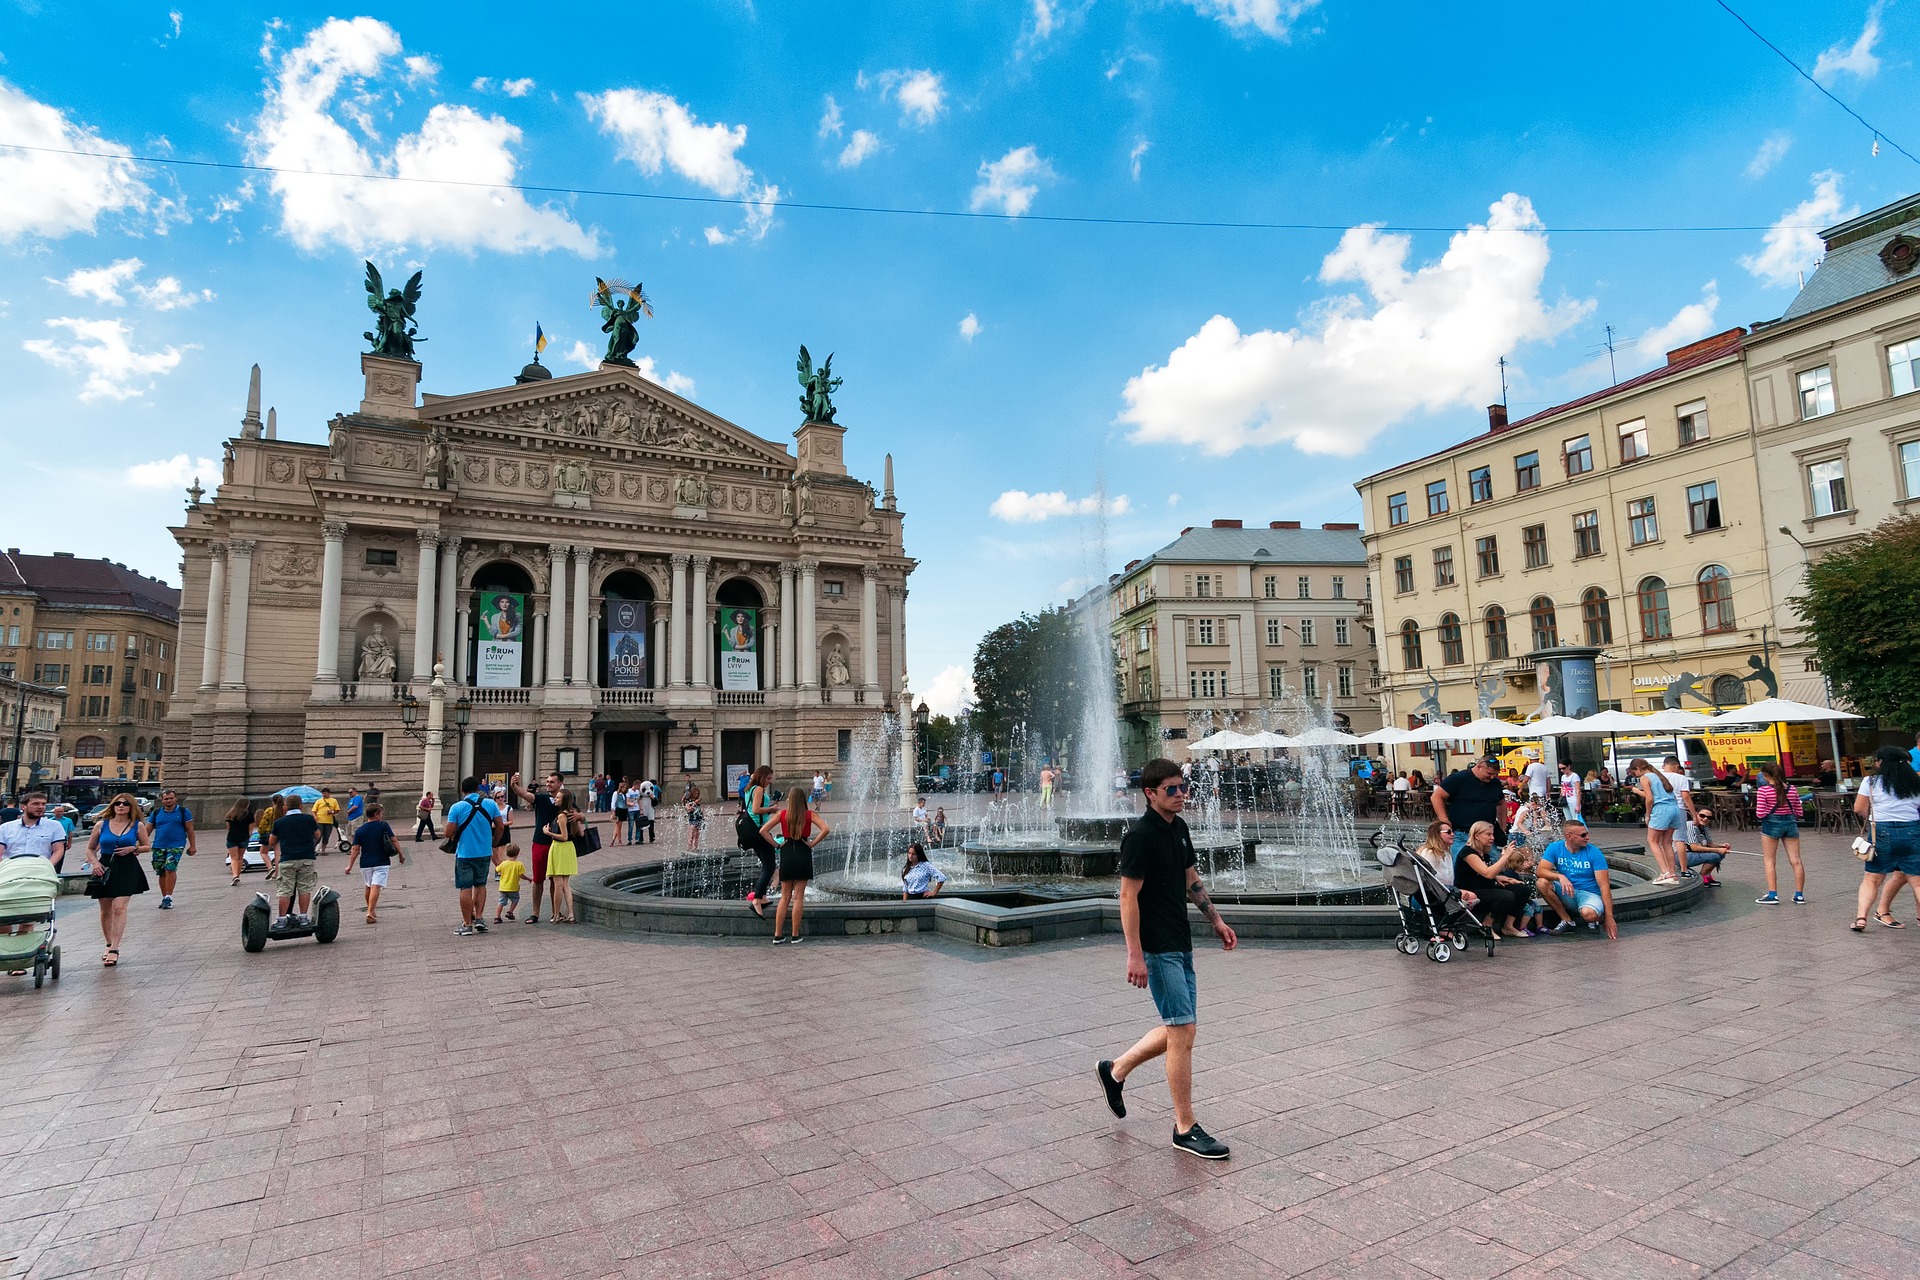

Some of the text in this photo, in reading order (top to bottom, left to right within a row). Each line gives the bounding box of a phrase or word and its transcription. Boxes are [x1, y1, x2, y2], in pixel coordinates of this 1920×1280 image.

[615, 654, 640, 667] 100
[614, 666, 640, 675] РОКІВ
[1707, 738, 1752, 746] ЛЬВОВОМ
